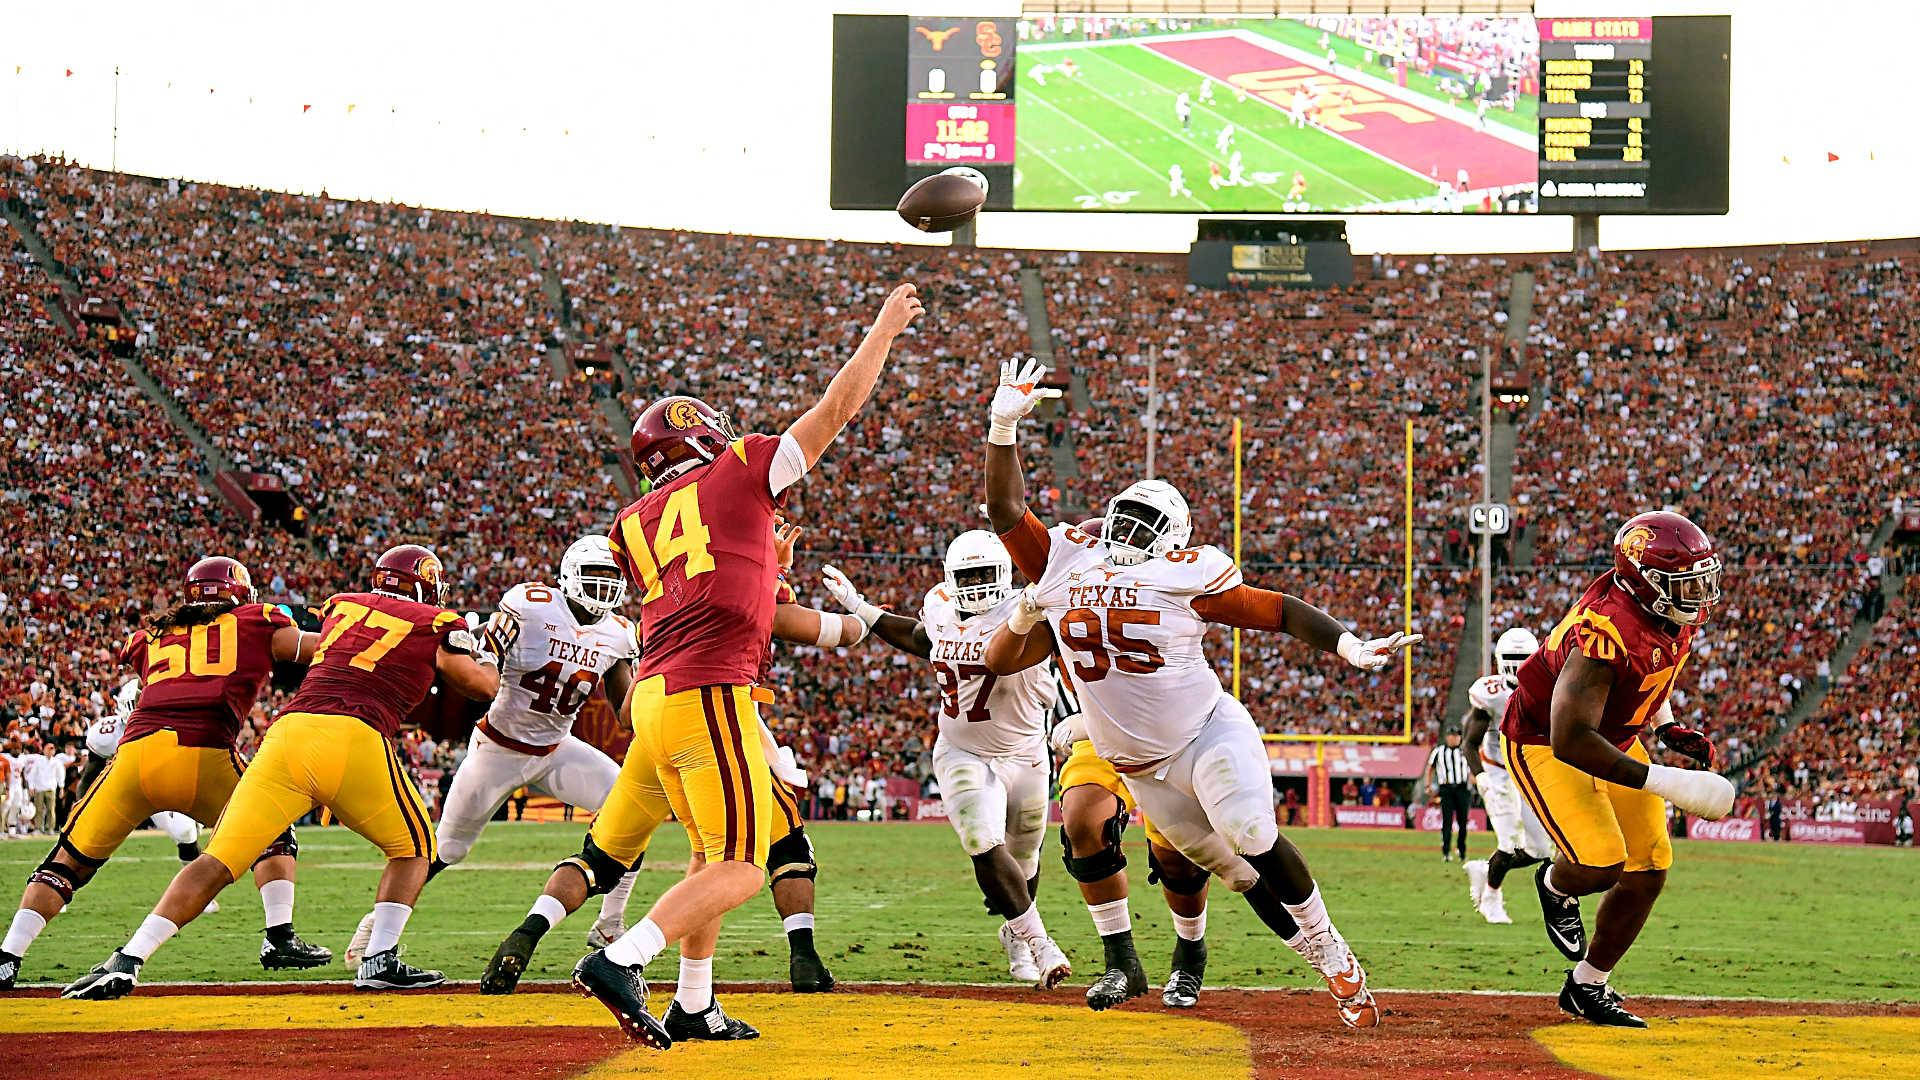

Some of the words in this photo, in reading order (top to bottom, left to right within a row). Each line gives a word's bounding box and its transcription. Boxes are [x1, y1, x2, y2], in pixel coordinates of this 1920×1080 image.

[621, 482, 716, 605] 14
[1069, 586, 1138, 607] TEXAS
[146, 612, 238, 685] 50
[310, 600, 415, 672] 77
[549, 637, 600, 668] TEXAS
[935, 639, 983, 661] TEXAS
[1059, 608, 1165, 682] 95
[1580, 628, 1616, 660] 70
[519, 660, 600, 715] 40
